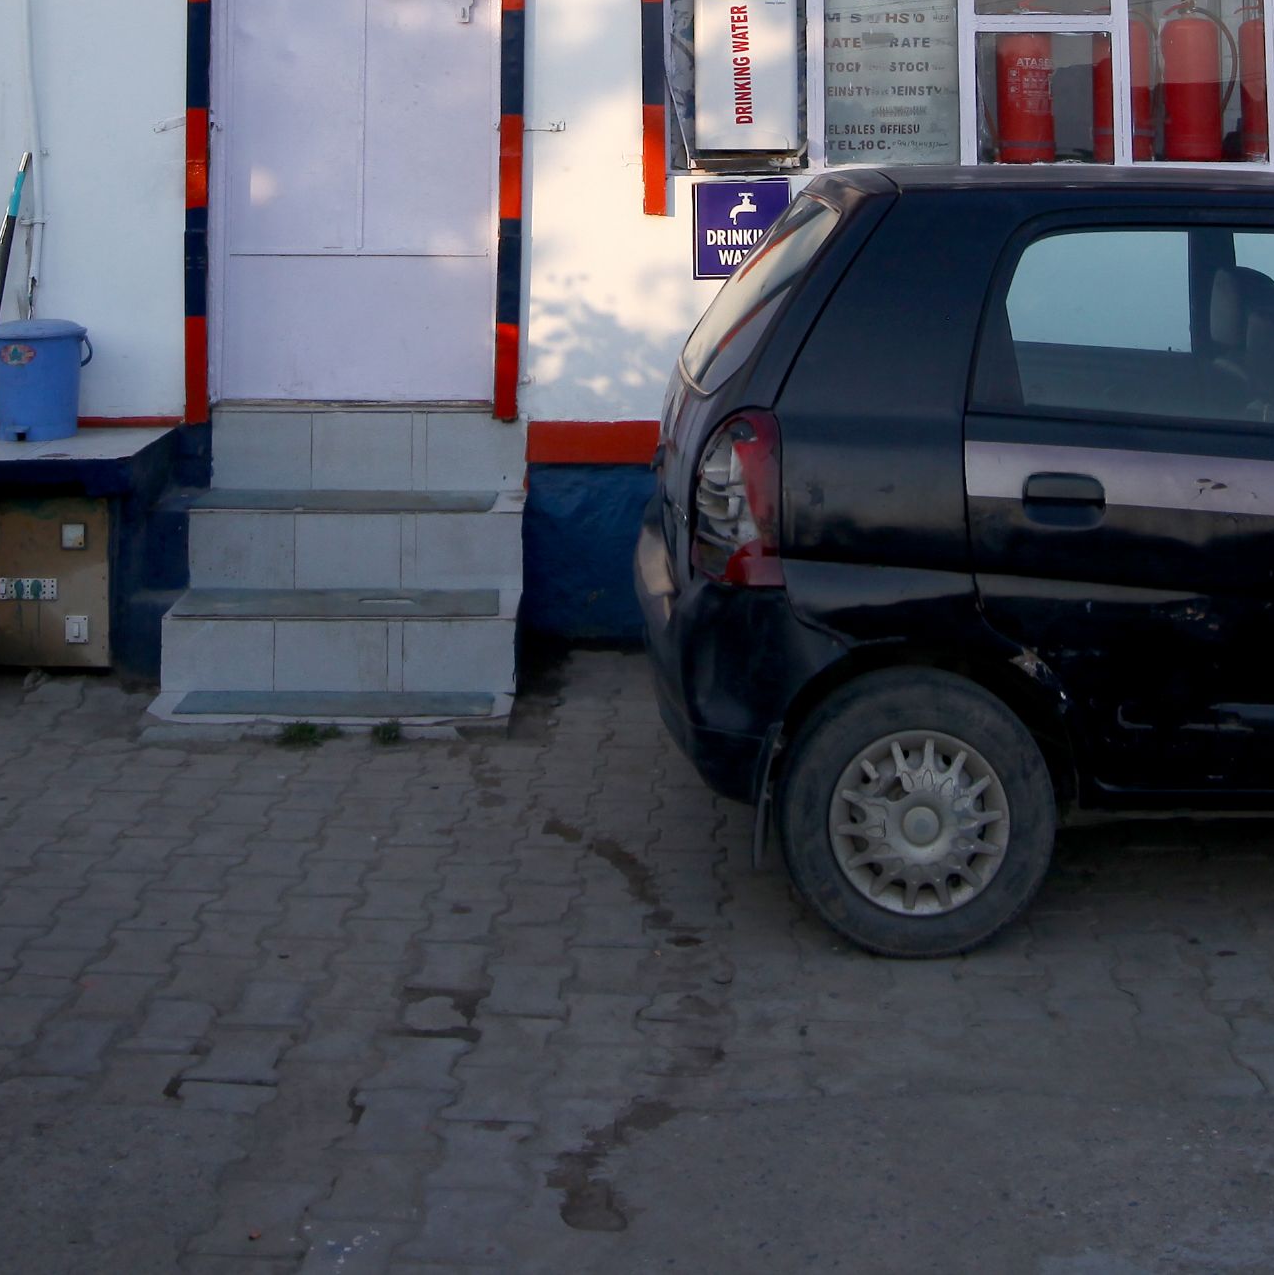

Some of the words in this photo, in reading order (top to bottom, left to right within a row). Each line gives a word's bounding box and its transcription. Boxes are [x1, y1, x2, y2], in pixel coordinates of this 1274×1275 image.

[730, 5, 750, 53] WATER
[889, 37, 931, 48] RATE
[732, 56, 753, 125] DRINKING
